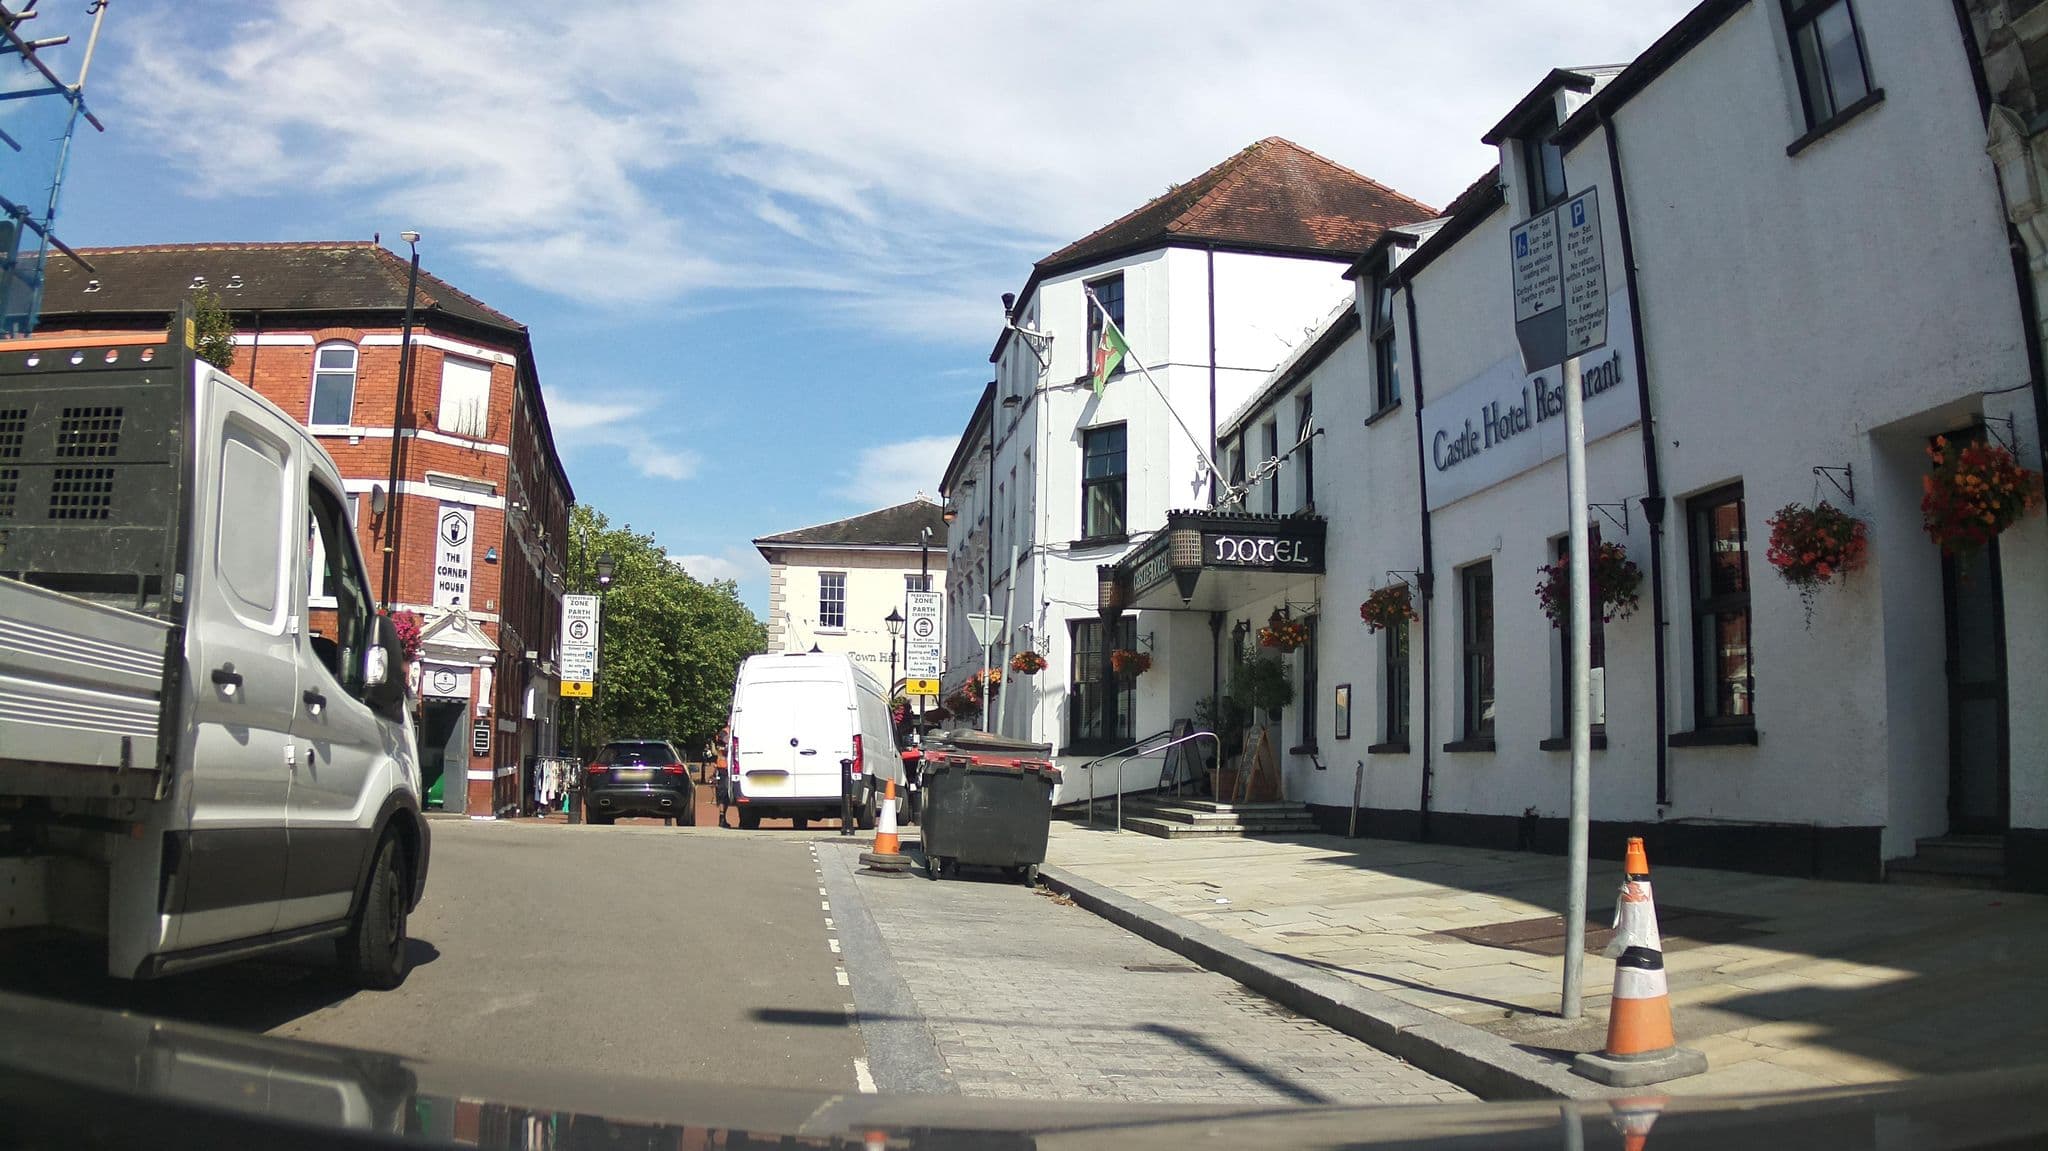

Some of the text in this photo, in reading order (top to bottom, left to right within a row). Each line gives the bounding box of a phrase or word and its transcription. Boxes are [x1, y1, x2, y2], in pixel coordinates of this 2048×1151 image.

[1542, 216, 1550, 226] Sat
[1574, 204, 1582, 224] P
[1542, 229, 1552, 240] Sad
[1568, 231, 1579, 240] Mon
[1582, 224, 1591, 234] Sat
[1546, 240, 1554, 250] pm
[1572, 241, 1579, 250] am
[1586, 234, 1594, 244] pm
[1578, 246, 1588, 256] hour
[1534, 253, 1552, 266] vehicles
[1571, 256, 1594, 270] No return
[1540, 264, 1550, 275] only
[1566, 272, 1581, 282] within
[1586, 264, 1600, 274] hours
[1572, 284, 1583, 294] Llun
[1586, 277, 1596, 289] Sad
[1576, 295, 1583, 303] am
[1590, 289, 1599, 298] pm
[1568, 318, 1577, 328] Dim
[1433, 349, 1623, 472] Castle Hotel Resrant
[446, 552, 460, 564] THE
[438, 566, 468, 580] CORNER
[440, 580, 464, 594] HOUSE
[848, 652, 876, 662] Town
[880, 652, 900, 662] Hal
